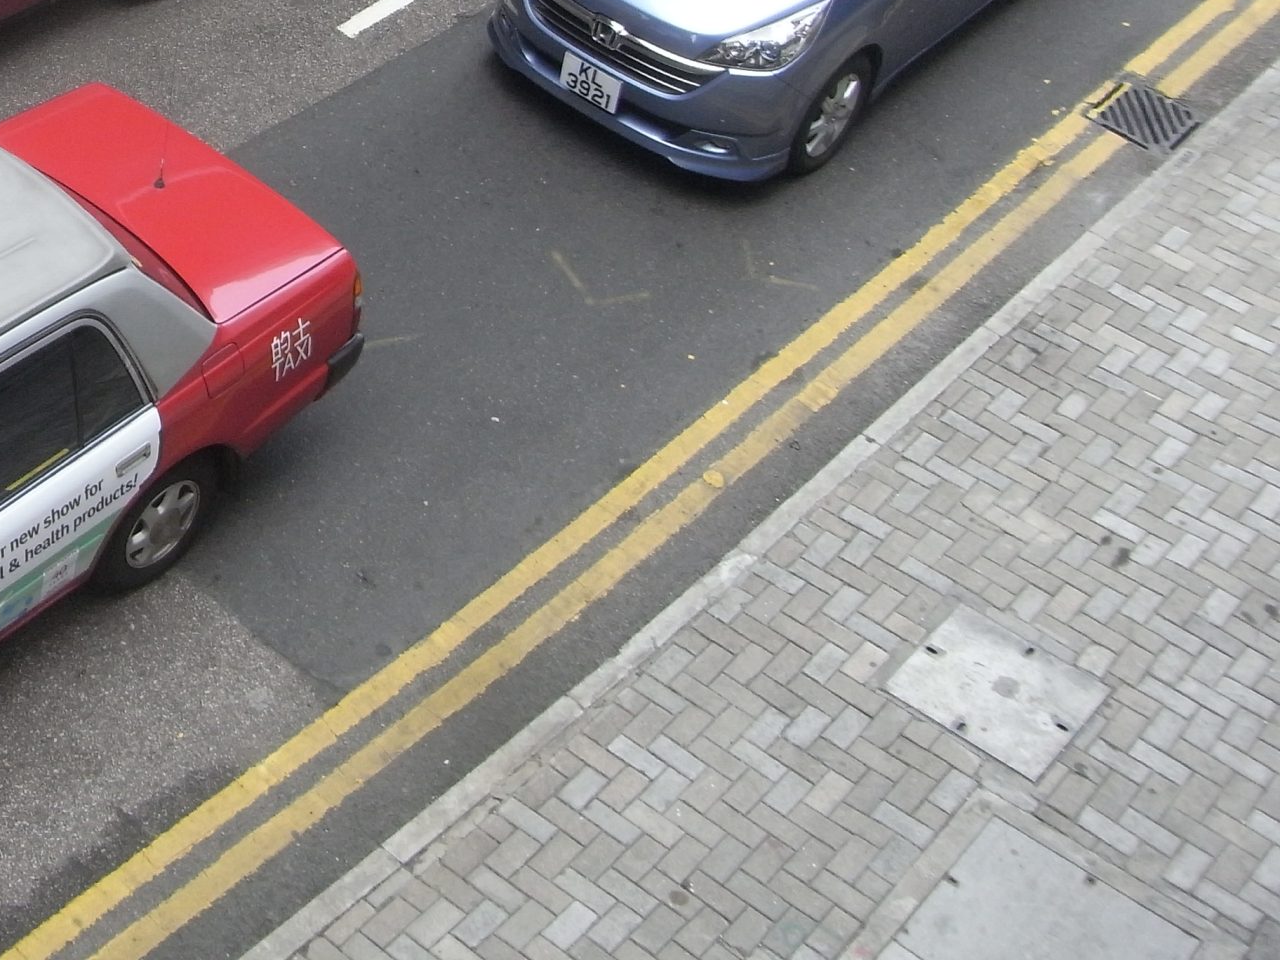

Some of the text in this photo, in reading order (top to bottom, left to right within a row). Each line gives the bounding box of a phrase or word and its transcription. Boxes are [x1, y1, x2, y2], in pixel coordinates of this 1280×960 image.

[566, 72, 611, 109] 3921
[579, 62, 602, 88] KL
[8, 556, 21, 573] &
[24, 524, 70, 563] health
[73, 473, 138, 532] products!
[10, 523, 40, 552] new
[43, 494, 82, 529] show
[84, 478, 105, 501] for
